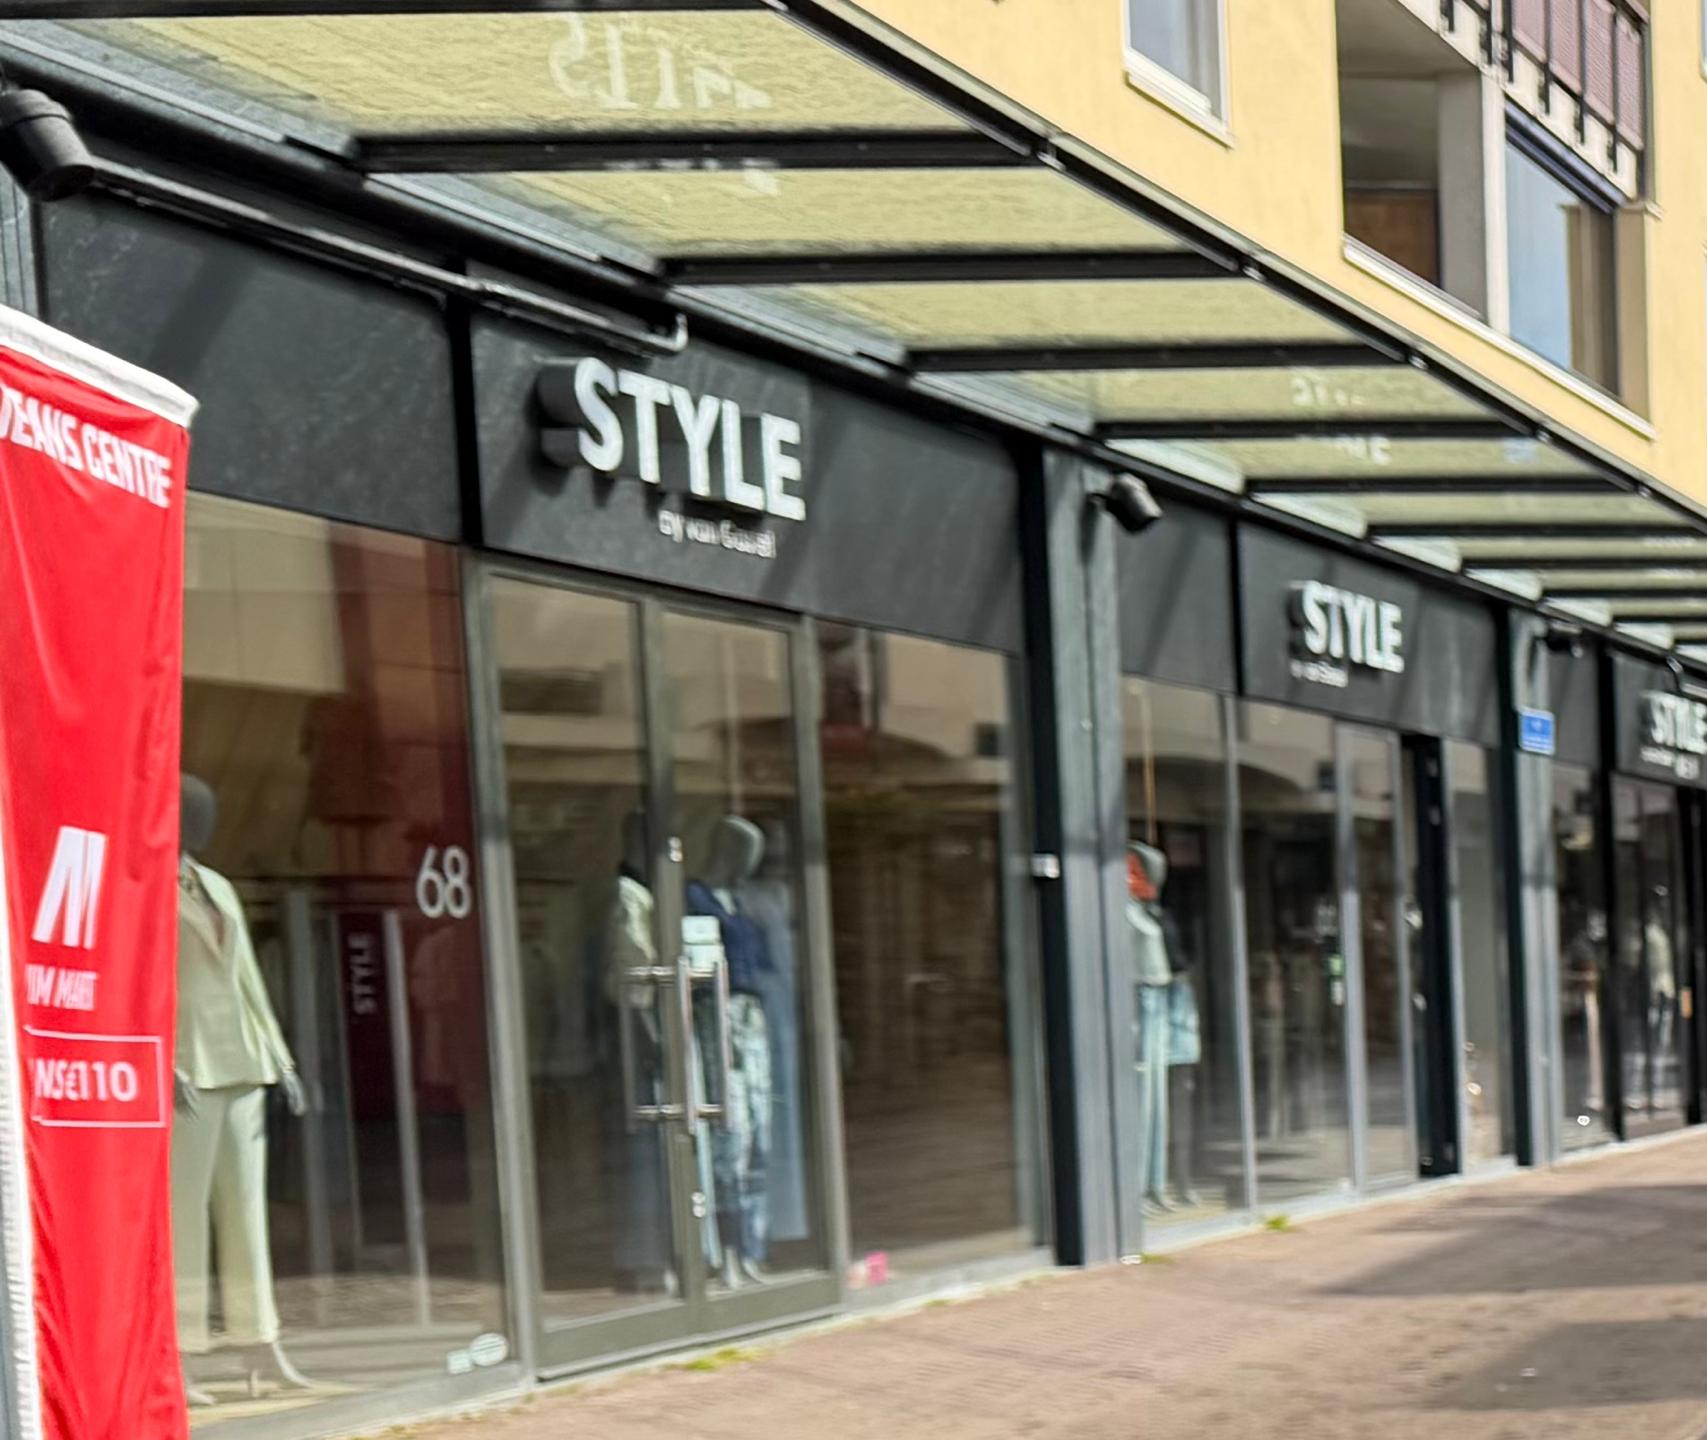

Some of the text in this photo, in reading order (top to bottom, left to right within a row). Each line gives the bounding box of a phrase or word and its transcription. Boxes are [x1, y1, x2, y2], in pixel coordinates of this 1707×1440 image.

[574, 356, 807, 521] STYLE
[1302, 580, 1405, 674] STYLE
[416, 845, 473, 919] 68
